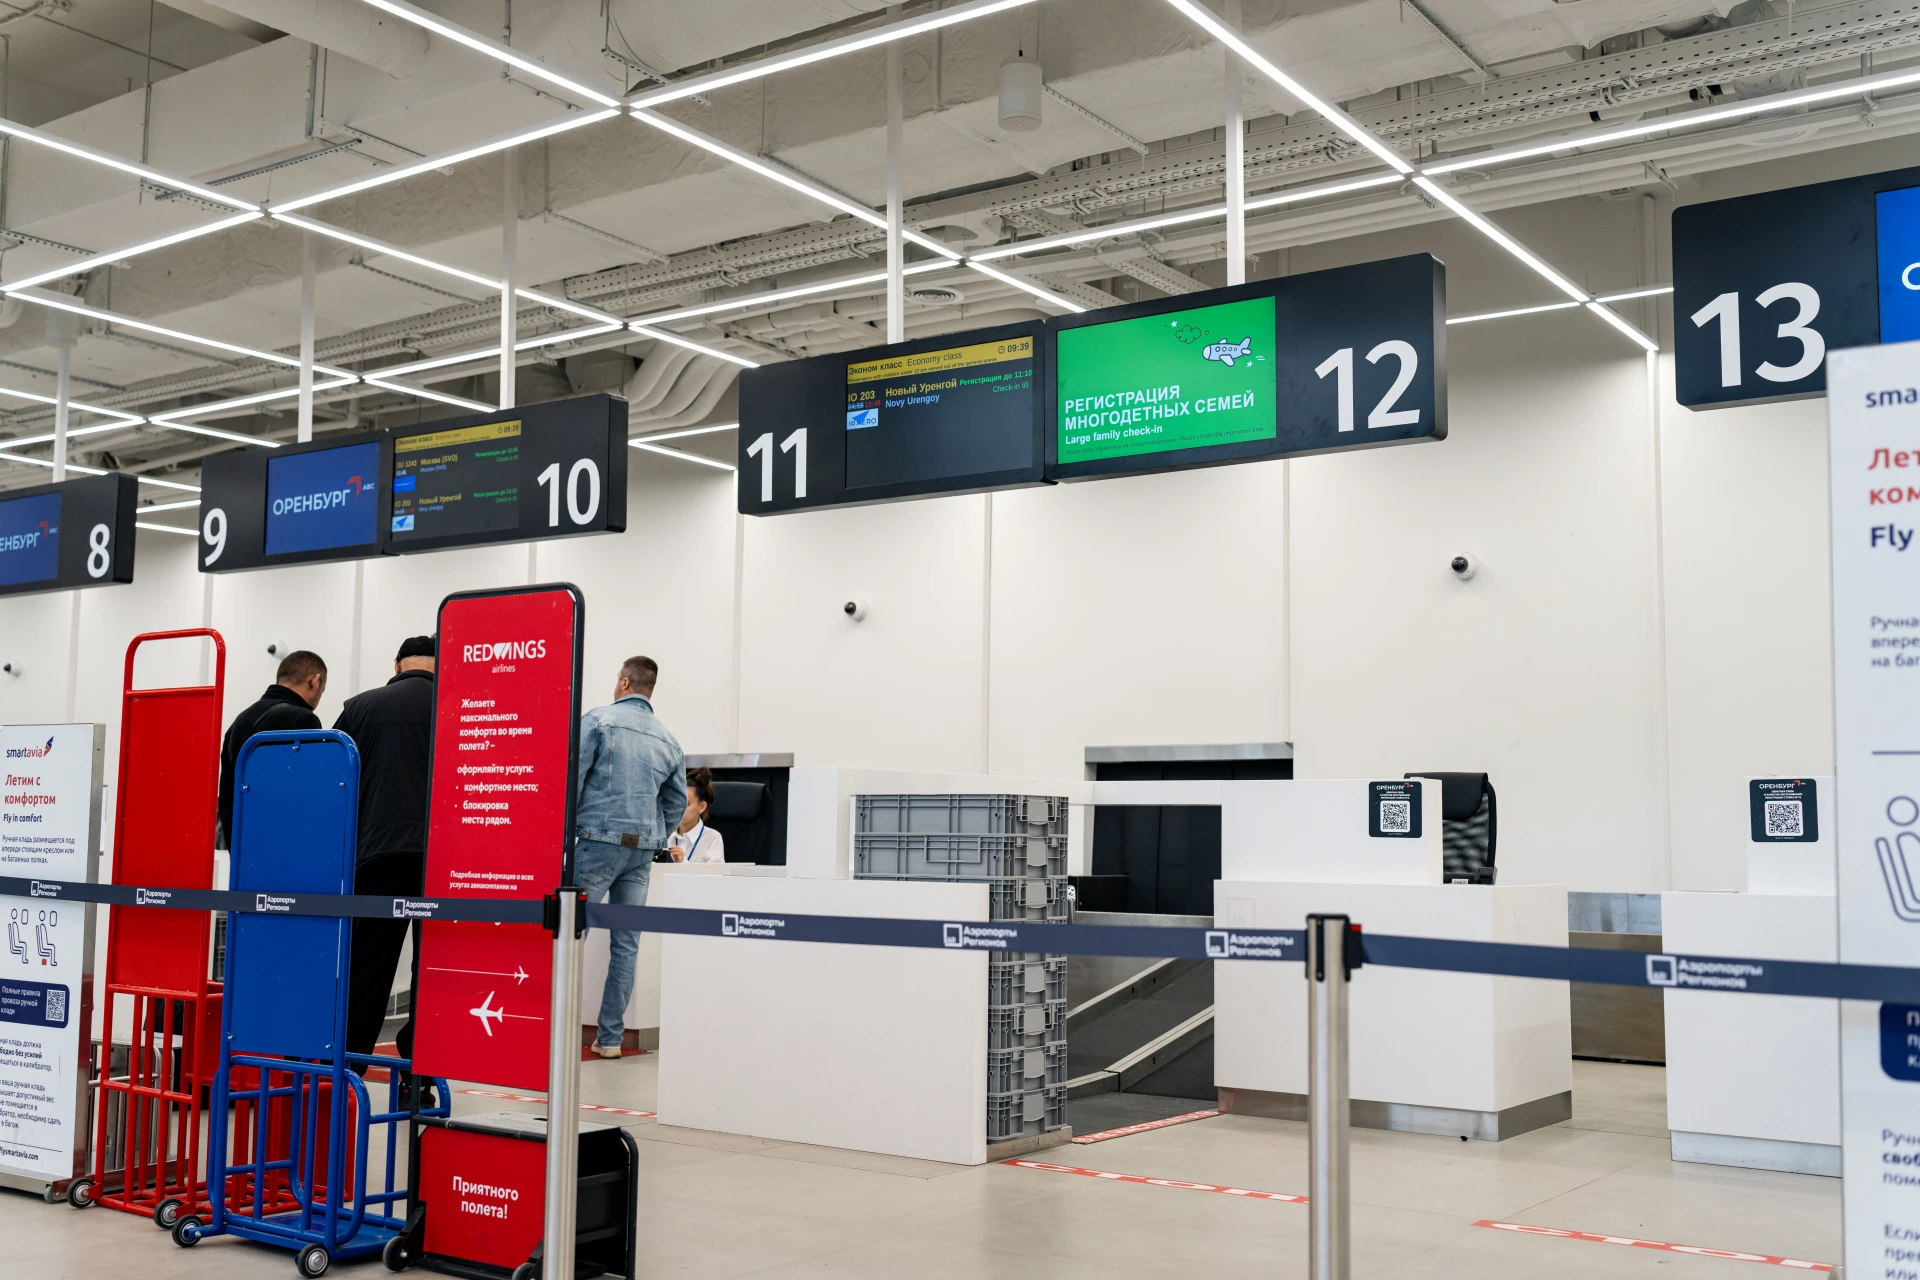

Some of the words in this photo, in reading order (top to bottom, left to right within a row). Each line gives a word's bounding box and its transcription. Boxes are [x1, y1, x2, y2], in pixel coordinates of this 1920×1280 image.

[1690, 282, 1825, 387] 13
[1007, 342, 1030, 352] 09:39
[907, 356, 941, 367] Economy
[943, 352, 963, 361] class
[848, 365, 878, 376] Эконом
[880, 361, 903, 371] класс
[959, 374, 1002, 386] Регистрация
[1003, 372, 1013, 382] до
[1014, 369, 1033, 379] 11:10
[885, 384, 917, 397] Новый
[919, 378, 957, 394] Уренгой
[992, 382, 1021, 393] Check-in
[1021, 381, 1029, 389] till
[1314, 340, 1420, 432] 12
[860, 390, 875, 401] 203
[885, 399, 905, 408] Novy
[907, 393, 940, 405] Urengoy
[1065, 385, 1180, 413] РЕГИСТРАЦИЯ
[1065, 402, 1190, 431] МНОГОДЕТНЫХ
[1194, 389, 1254, 414] СЕМЕЙ
[503, 425, 519, 433] 09:39
[1065, 435, 1091, 445] Large
[1093, 430, 1120, 441] family
[1123, 424, 1163, 437] check-in
[396, 461, 405, 469] SU
[420, 458, 441, 466] Москва
[441, 454, 458, 464] (SVO)
[746, 428, 807, 502] 11
[537, 458, 600, 527] 10
[272, 489, 351, 516] ОРЕНБУРГ
[419, 496, 438, 505] Новый
[439, 493, 462, 504] Уренгой
[203, 508, 227, 567] 9
[1870, 524, 1914, 551] Fly
[87, 523, 110, 578] 8
[1872, 657, 1890, 667] на
[491, 664, 516, 673] airlines
[461, 698, 496, 709] Желаете
[460, 713, 519, 722] максимального
[459, 726, 497, 739] комфорта
[498, 728, 507, 736] во
[508, 727, 532, 738] время
[458, 740, 490, 751] полета?
[6, 746, 43, 758] smartavia
[457, 763, 504, 776] оформляйте
[505, 765, 534, 776] услуги:
[5, 774, 34, 786] Летим
[36, 776, 41, 786] с
[464, 781, 512, 794] комфортное
[512, 783, 539, 793] место;
[4, 791, 56, 807] комфортом
[462, 800, 509, 812] блокировка
[3, 813, 12, 823] Fly
[13, 813, 18, 822] in
[19, 813, 43, 823] comfort
[462, 816, 484, 824] места
[485, 816, 512, 826] рядом.
[2, 834, 18, 843] Ручная
[450, 870, 480, 880] Подробная
[481, 871, 516, 881] информация
[470, 882, 509, 890] авиакомпании
[146, 890, 172, 898] Аэропорты
[267, 896, 296, 904] Аэропорты
[145, 897, 166, 905] Регионов
[405, 901, 439, 909] Аэропорты
[267, 904, 290, 912] Регионов
[405, 909, 432, 917] Регионов
[739, 916, 785, 928] Аэропорты
[738, 926, 776, 937] Регионов
[963, 926, 1017, 939] Аэропорты
[963, 936, 1007, 948] Регионов
[1230, 934, 1294, 947] Аэропорты
[1229, 945, 1282, 957] Регионов
[1678, 959, 1763, 977] Аэропорты
[1678, 972, 1747, 989] Регионов
[15, 1049, 24, 1057] без
[16, 1091, 45, 1100] допустимый
[5, 1100, 33, 1109] помещается
[47, 1117, 61, 1125] сдать
[452, 1175, 519, 1201] Приятного
[461, 1200, 508, 1220] полета!
